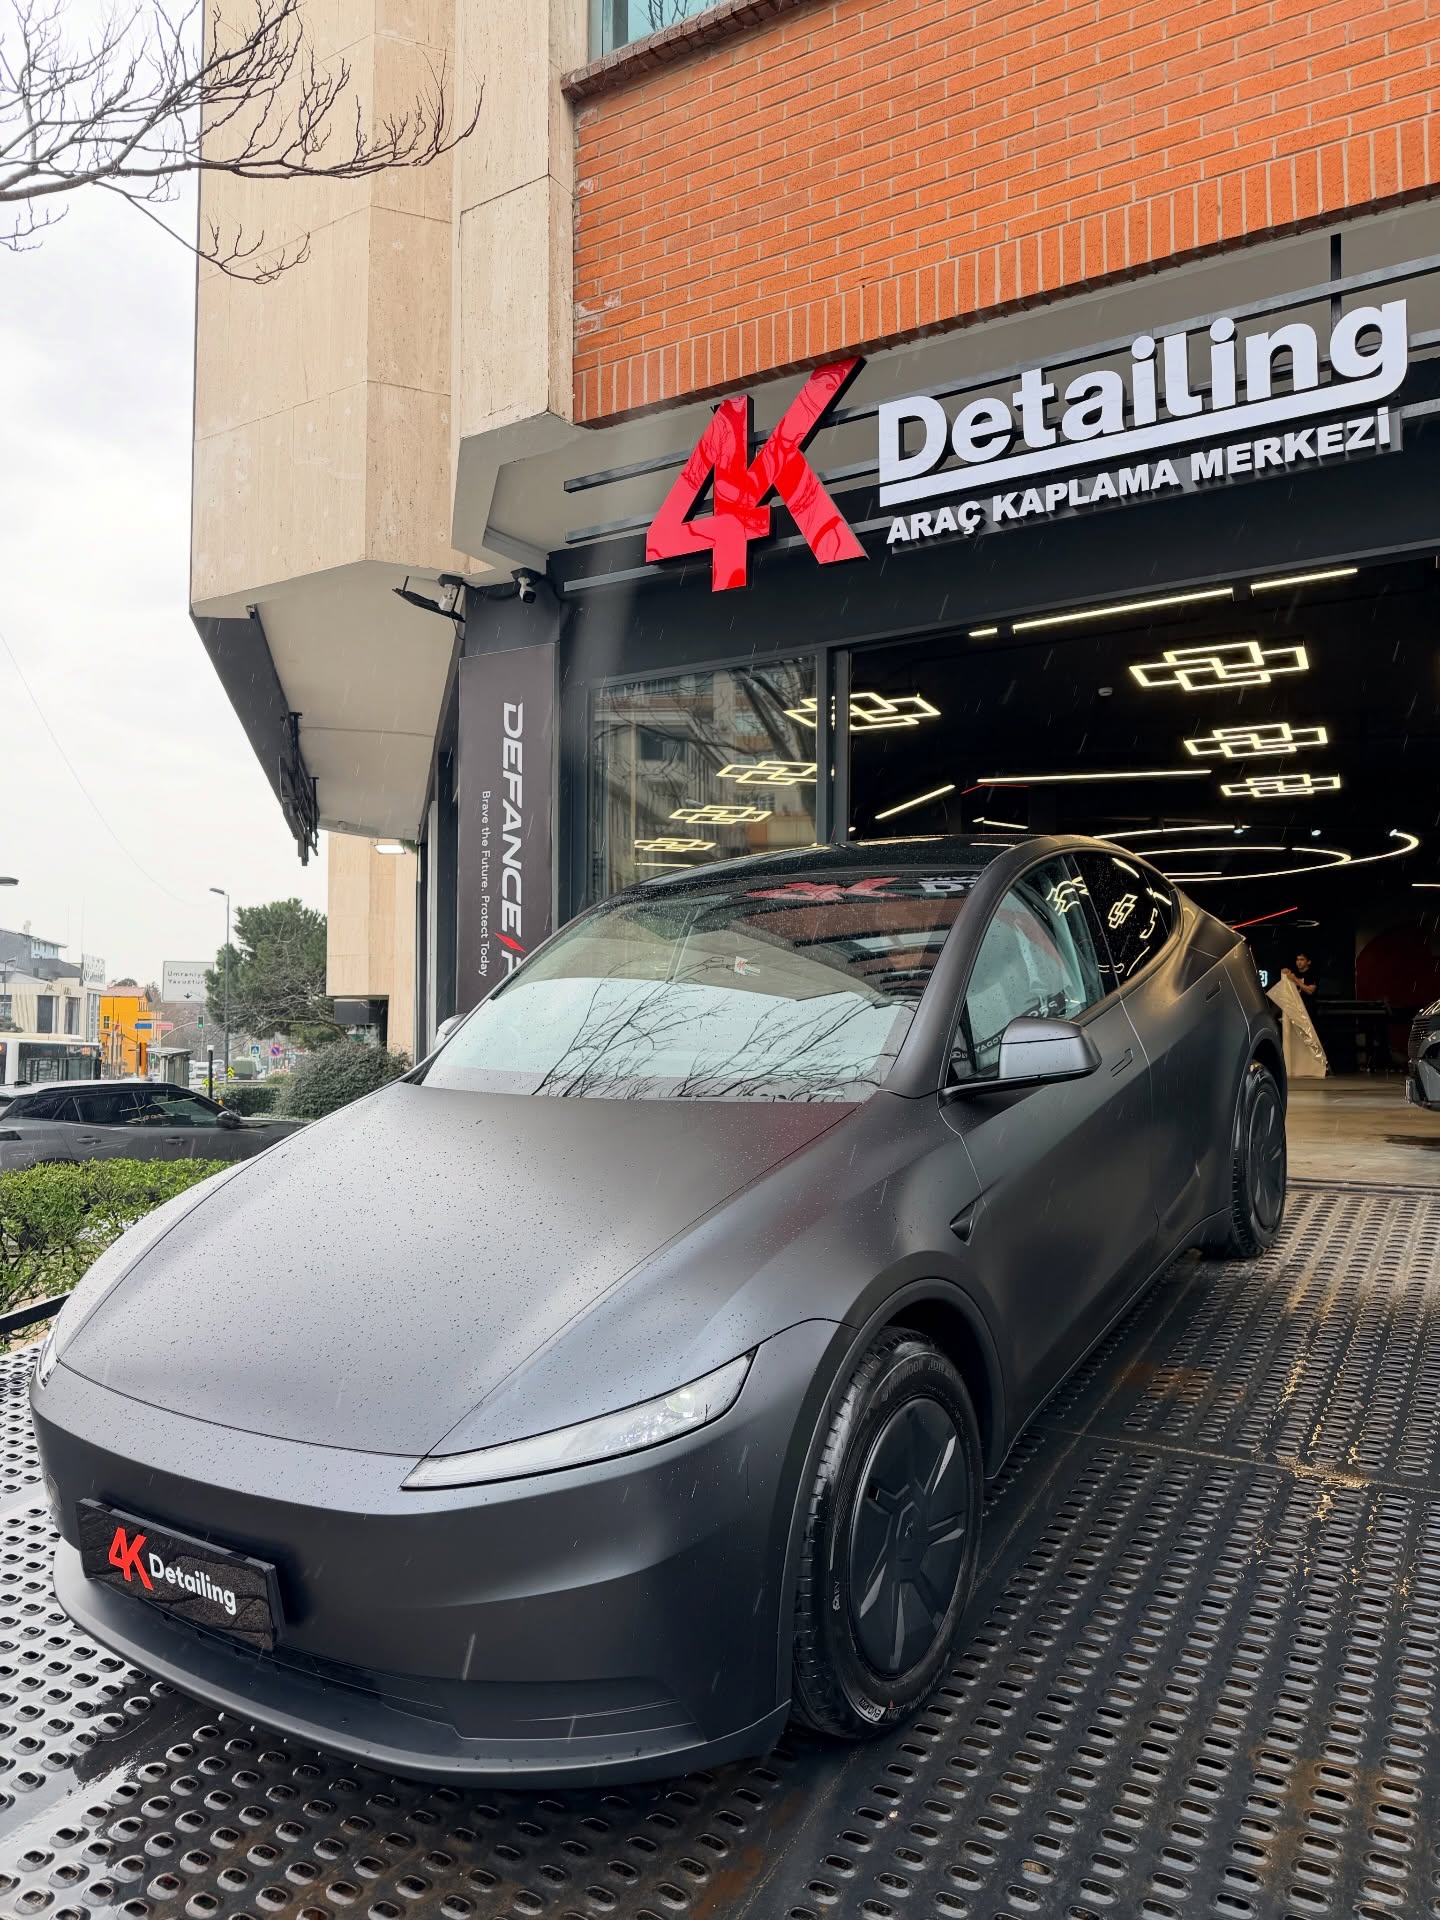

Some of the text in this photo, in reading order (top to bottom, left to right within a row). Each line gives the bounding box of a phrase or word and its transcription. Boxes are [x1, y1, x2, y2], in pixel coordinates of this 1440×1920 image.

[647, 299, 1408, 592] 4K Detailing
[886, 407, 1391, 545] ARAÇ KAPLAMA MERKEZİ
[478, 790, 491, 977] Brave the Future. Protect Today
[502, 701, 523, 938] DEFANCE
[108, 1526, 237, 1615] 4K Detailing
